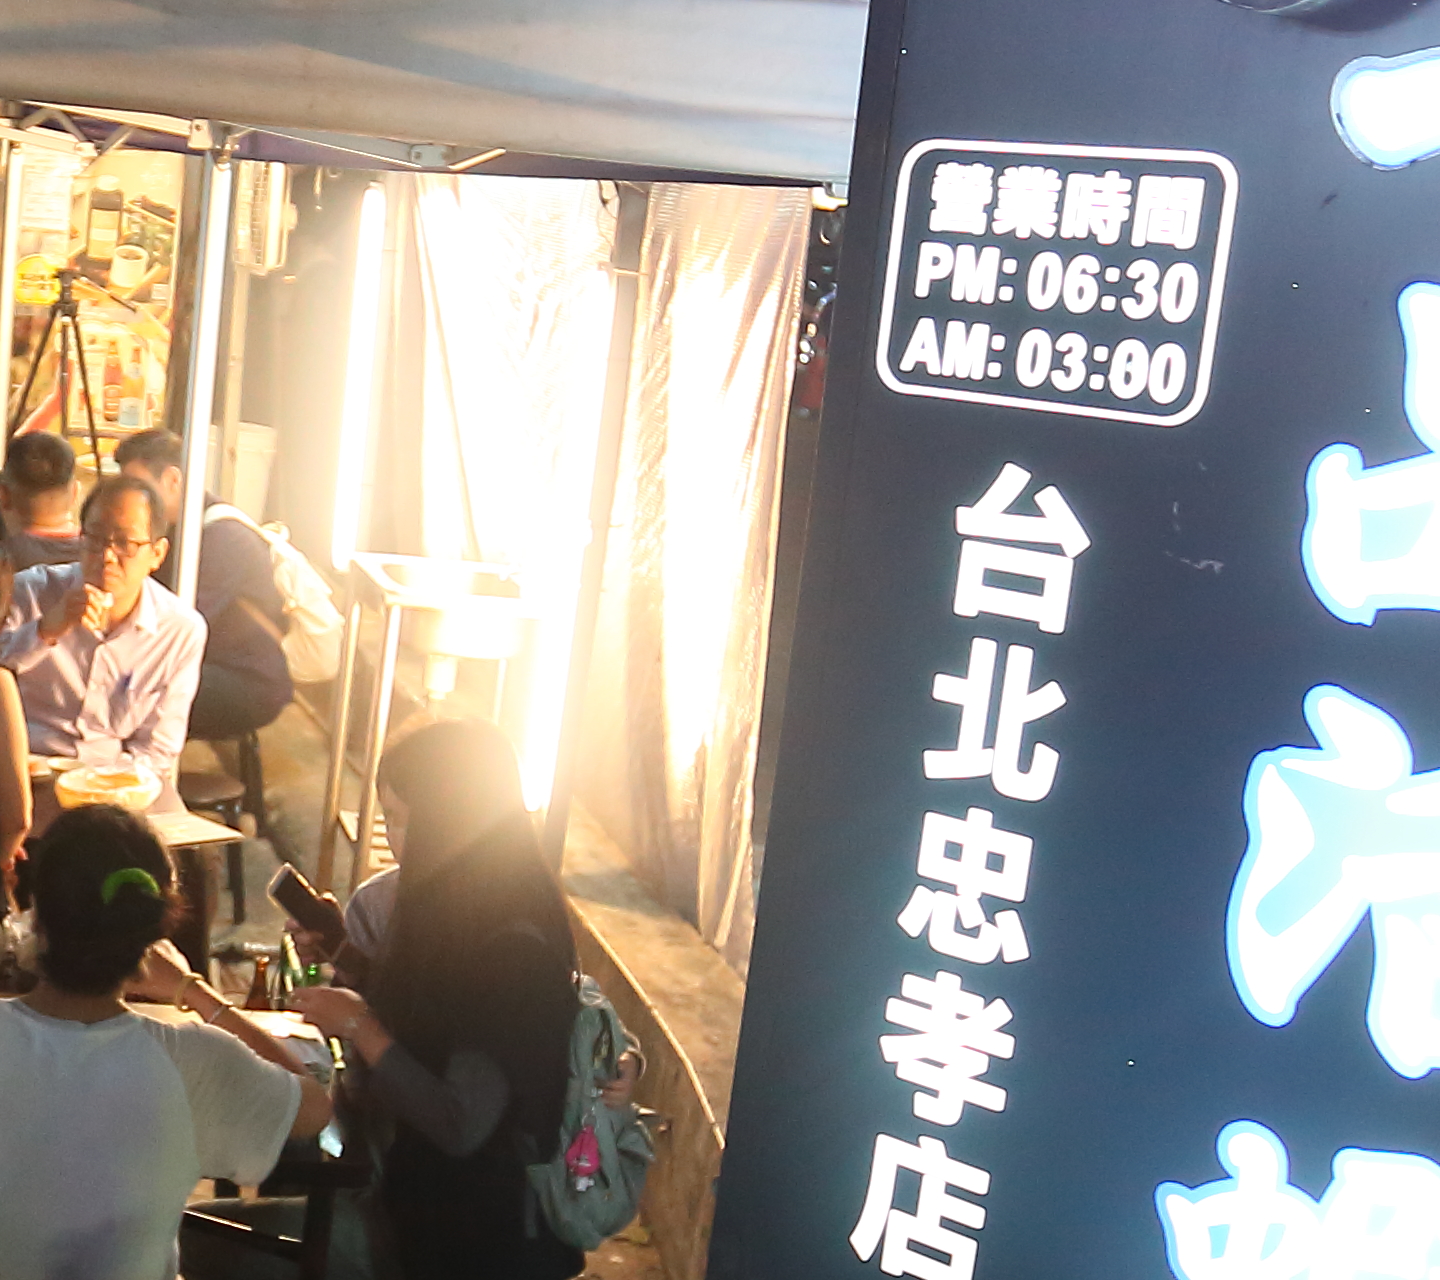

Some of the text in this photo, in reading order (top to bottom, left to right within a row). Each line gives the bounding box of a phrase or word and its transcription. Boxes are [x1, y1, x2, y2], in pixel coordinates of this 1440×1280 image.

[928, 161, 1207, 250] 營業時間
[914, 240, 1200, 324] PM: 06:30
[899, 316, 1188, 405] AM: 03:00
